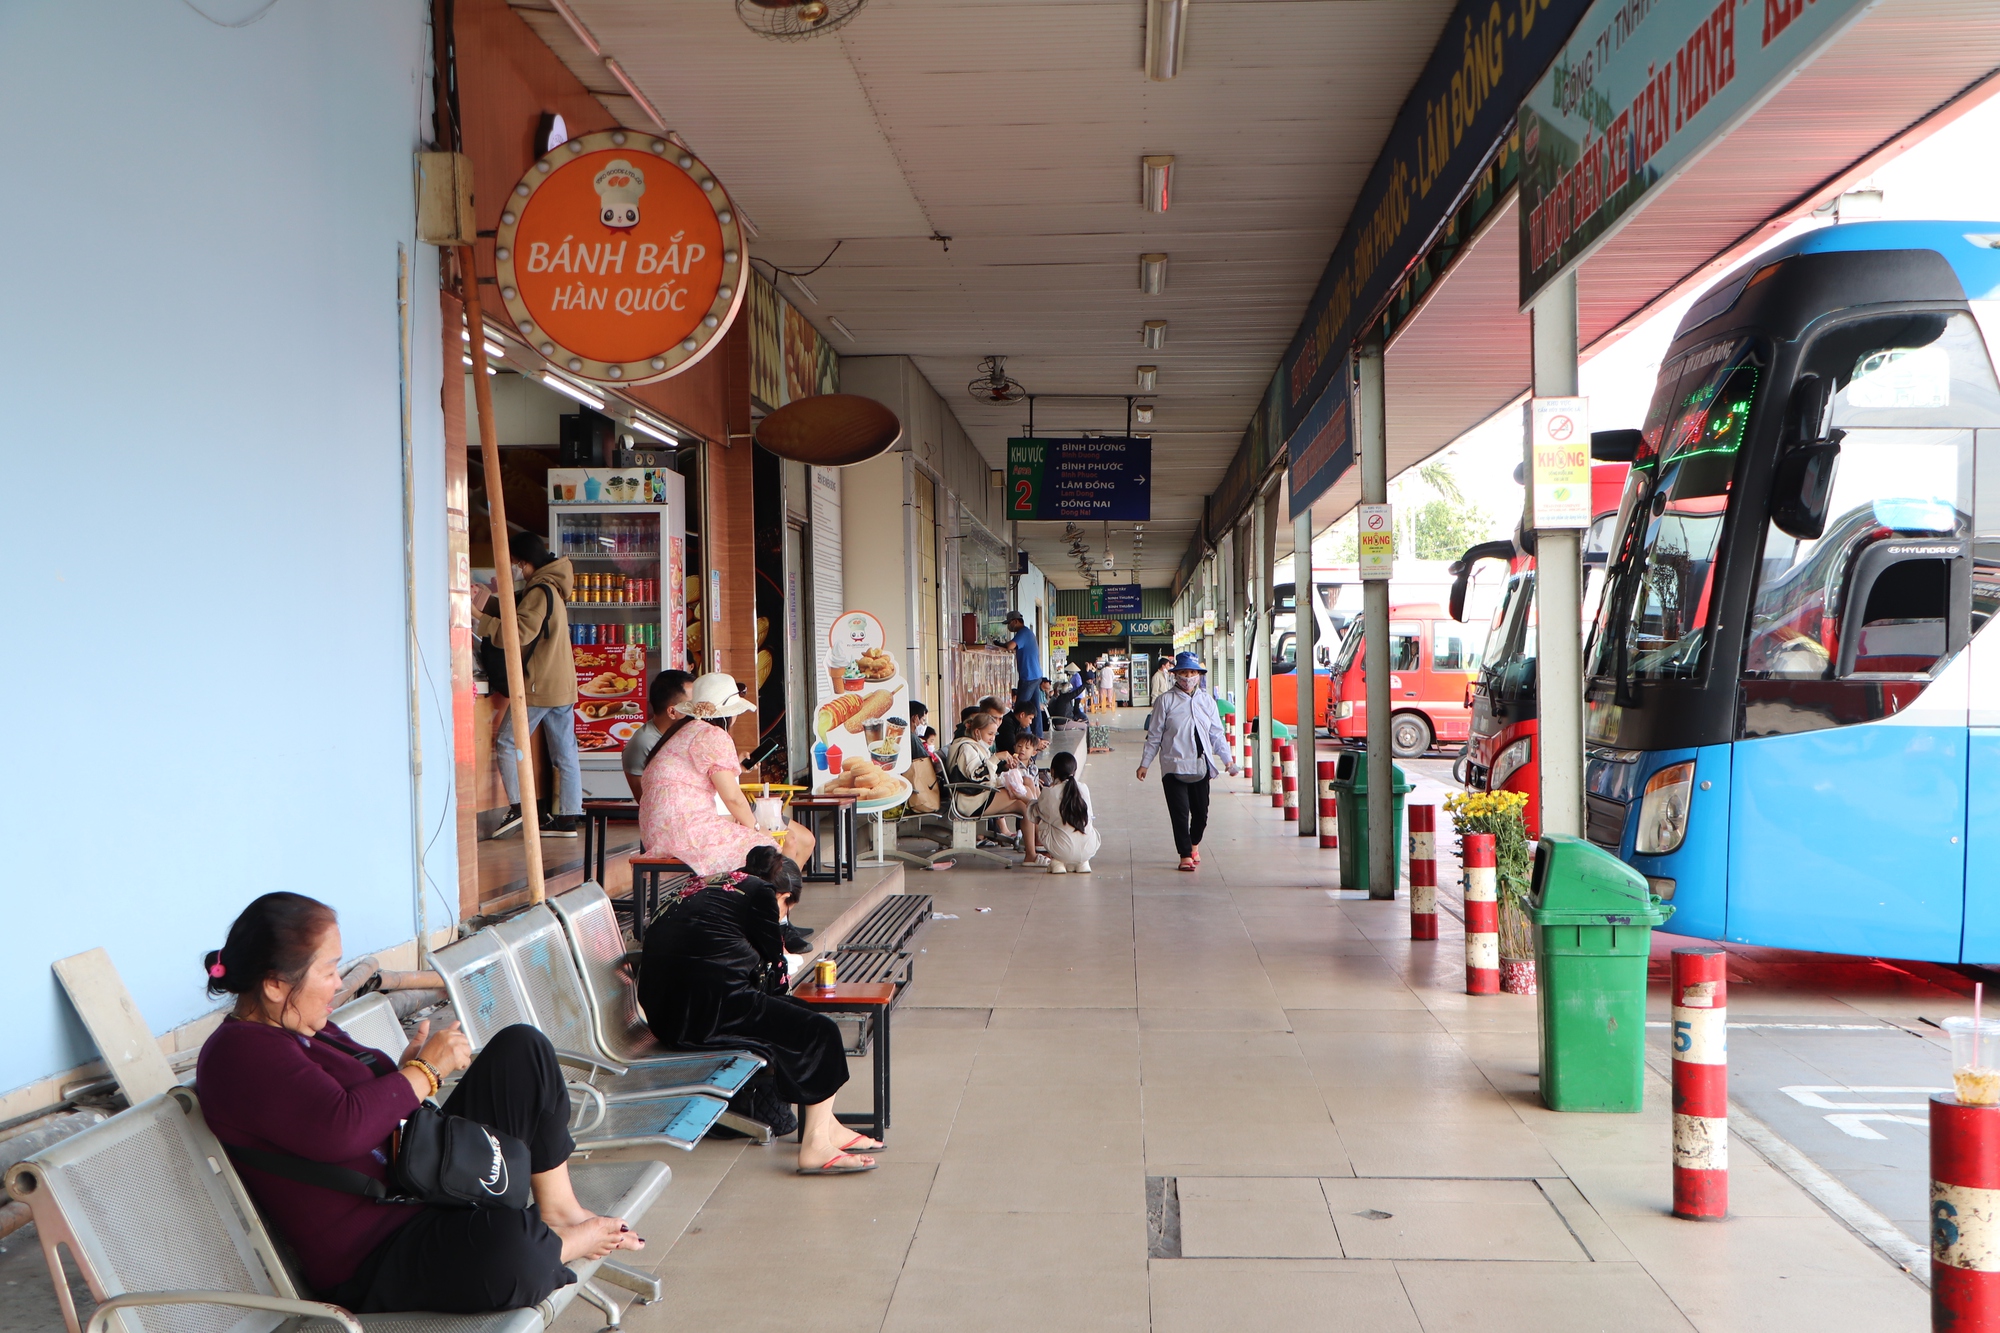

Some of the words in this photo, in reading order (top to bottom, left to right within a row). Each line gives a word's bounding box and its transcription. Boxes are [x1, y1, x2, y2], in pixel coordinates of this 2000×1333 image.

[1596, 24, 1611, 74] TY
[1374, 157, 1410, 267] PHƯỚC
[1418, 92, 1450, 200] LÂM
[1452, 0, 1502, 149] ĐỒNG
[1544, 165, 1572, 267] MỘT
[1574, 118, 1603, 233] BẾN
[1606, 108, 1628, 200] XE
[1632, 61, 1671, 174] VĂN
[1675, 0, 1736, 133] MINH
[527, 235, 627, 275] BÁNH
[636, 230, 705, 274] BẮP
[551, 282, 608, 311] HÀN
[615, 280, 687, 316] QUỐC
[1011, 447, 1026, 462] KHU
[1028, 445, 1044, 466] VỰC
[1088, 443, 1126, 452] DƯƠNG
[1538, 446, 1584, 469] KHÔNG
[1013, 465, 1031, 475] Area
[1061, 462, 1086, 470] BÌNH
[1088, 462, 1124, 471] PHƯỚC
[1015, 480, 1032, 510] 2
[1061, 481, 1082, 489] LÂM
[1363, 532, 1390, 546] KHÔNG
[1093, 601, 1098, 612] 1
[1130, 623, 1148, 632] K.09
[1464, 874, 1472, 892] 4
[1674, 1021, 1692, 1052] 5
[1932, 1200, 1959, 1247] 6
